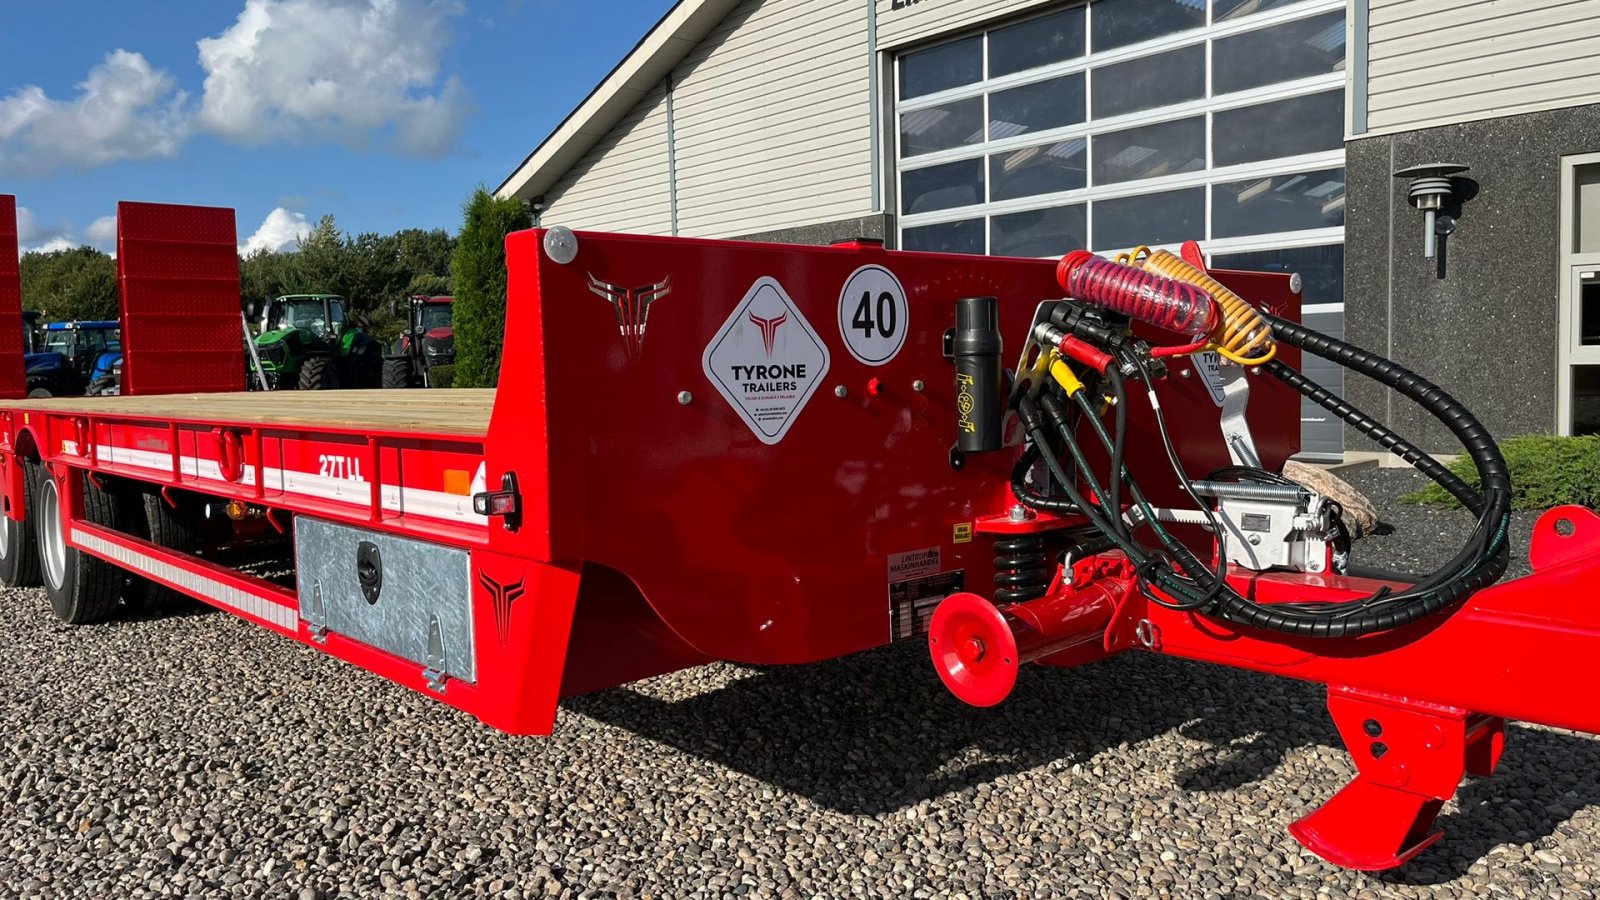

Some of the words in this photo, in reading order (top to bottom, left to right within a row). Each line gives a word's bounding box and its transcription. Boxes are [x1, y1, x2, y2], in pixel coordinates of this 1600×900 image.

[851, 290, 897, 339] 40
[730, 363, 807, 381] TYRONE
[742, 381, 798, 393] TRAILERS
[319, 454, 345, 480] 27T
[346, 456, 364, 482] LL
